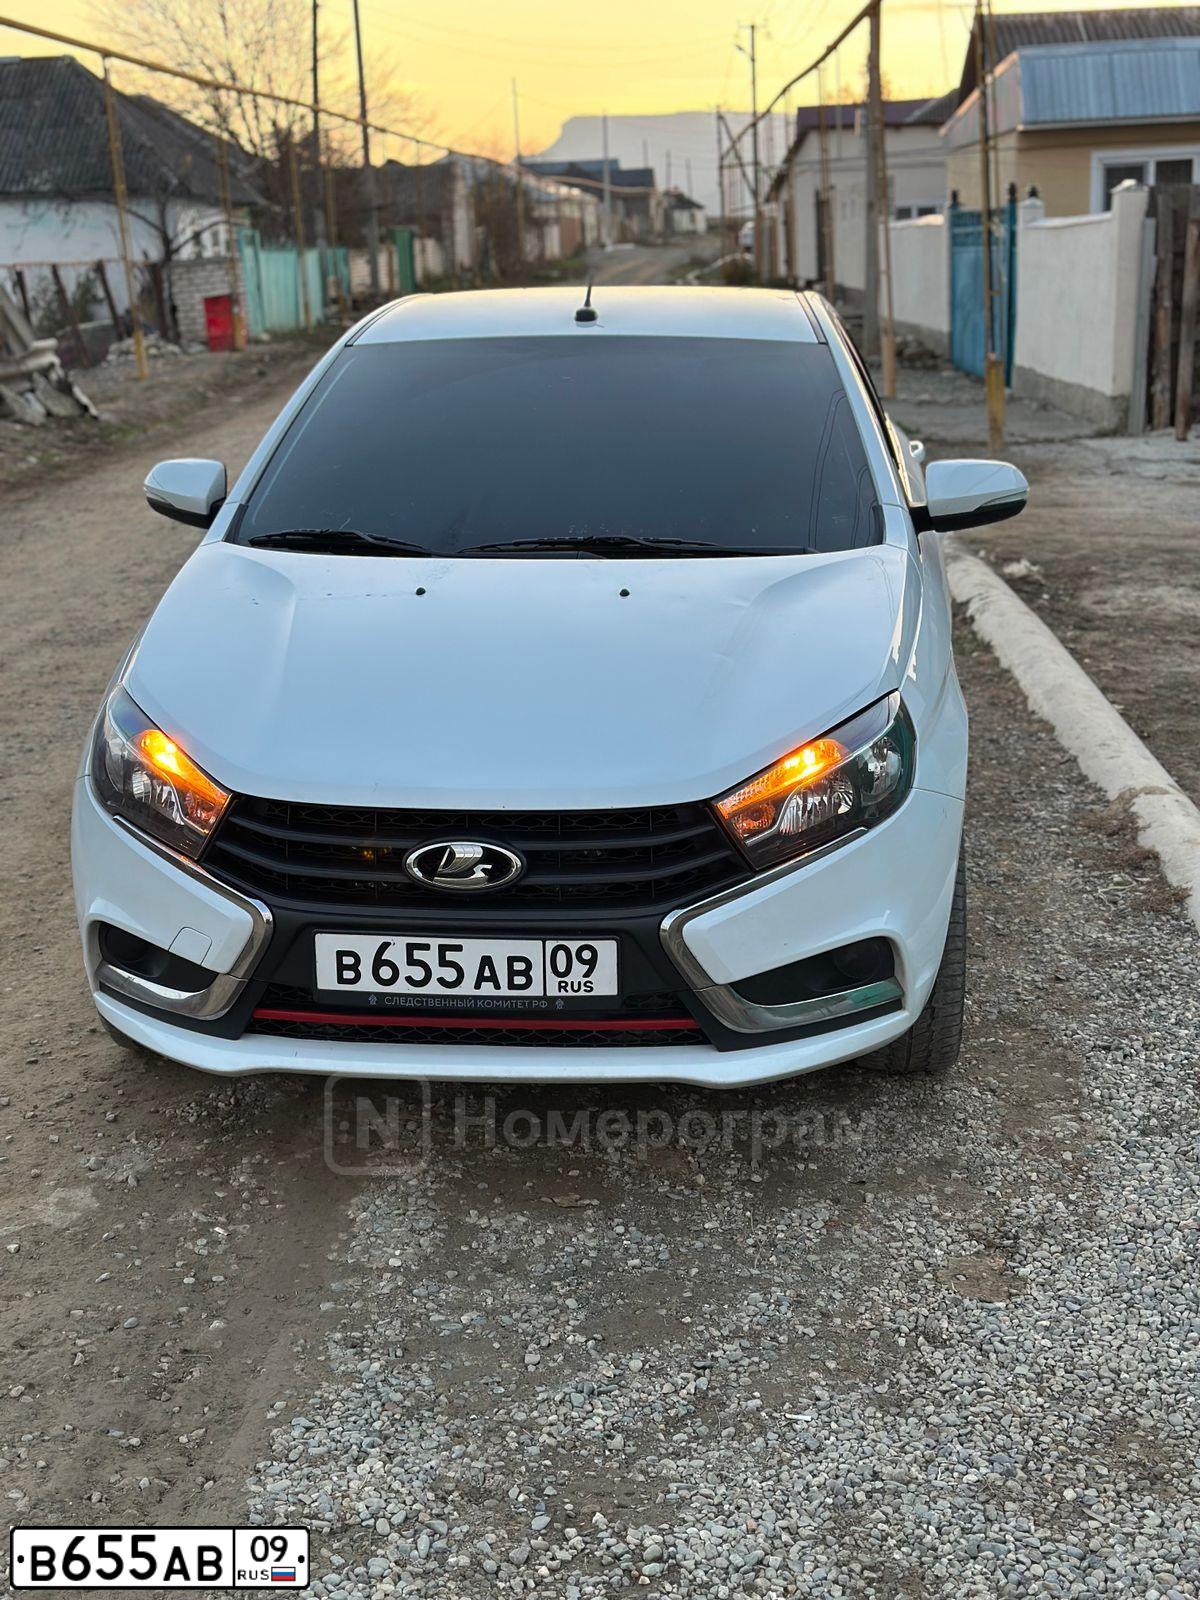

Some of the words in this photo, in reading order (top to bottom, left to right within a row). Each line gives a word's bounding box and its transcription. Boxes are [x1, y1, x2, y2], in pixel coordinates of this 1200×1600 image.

[335, 941, 533, 991] В655АВ
[549, 943, 599, 979] 09
[557, 980, 594, 994] RUS
[384, 996, 475, 1009] СЛЕДСТВЕННЫЙ
[477, 998, 530, 1009] КОМИТЕТ
[532, 1000, 548, 1010] РФ
